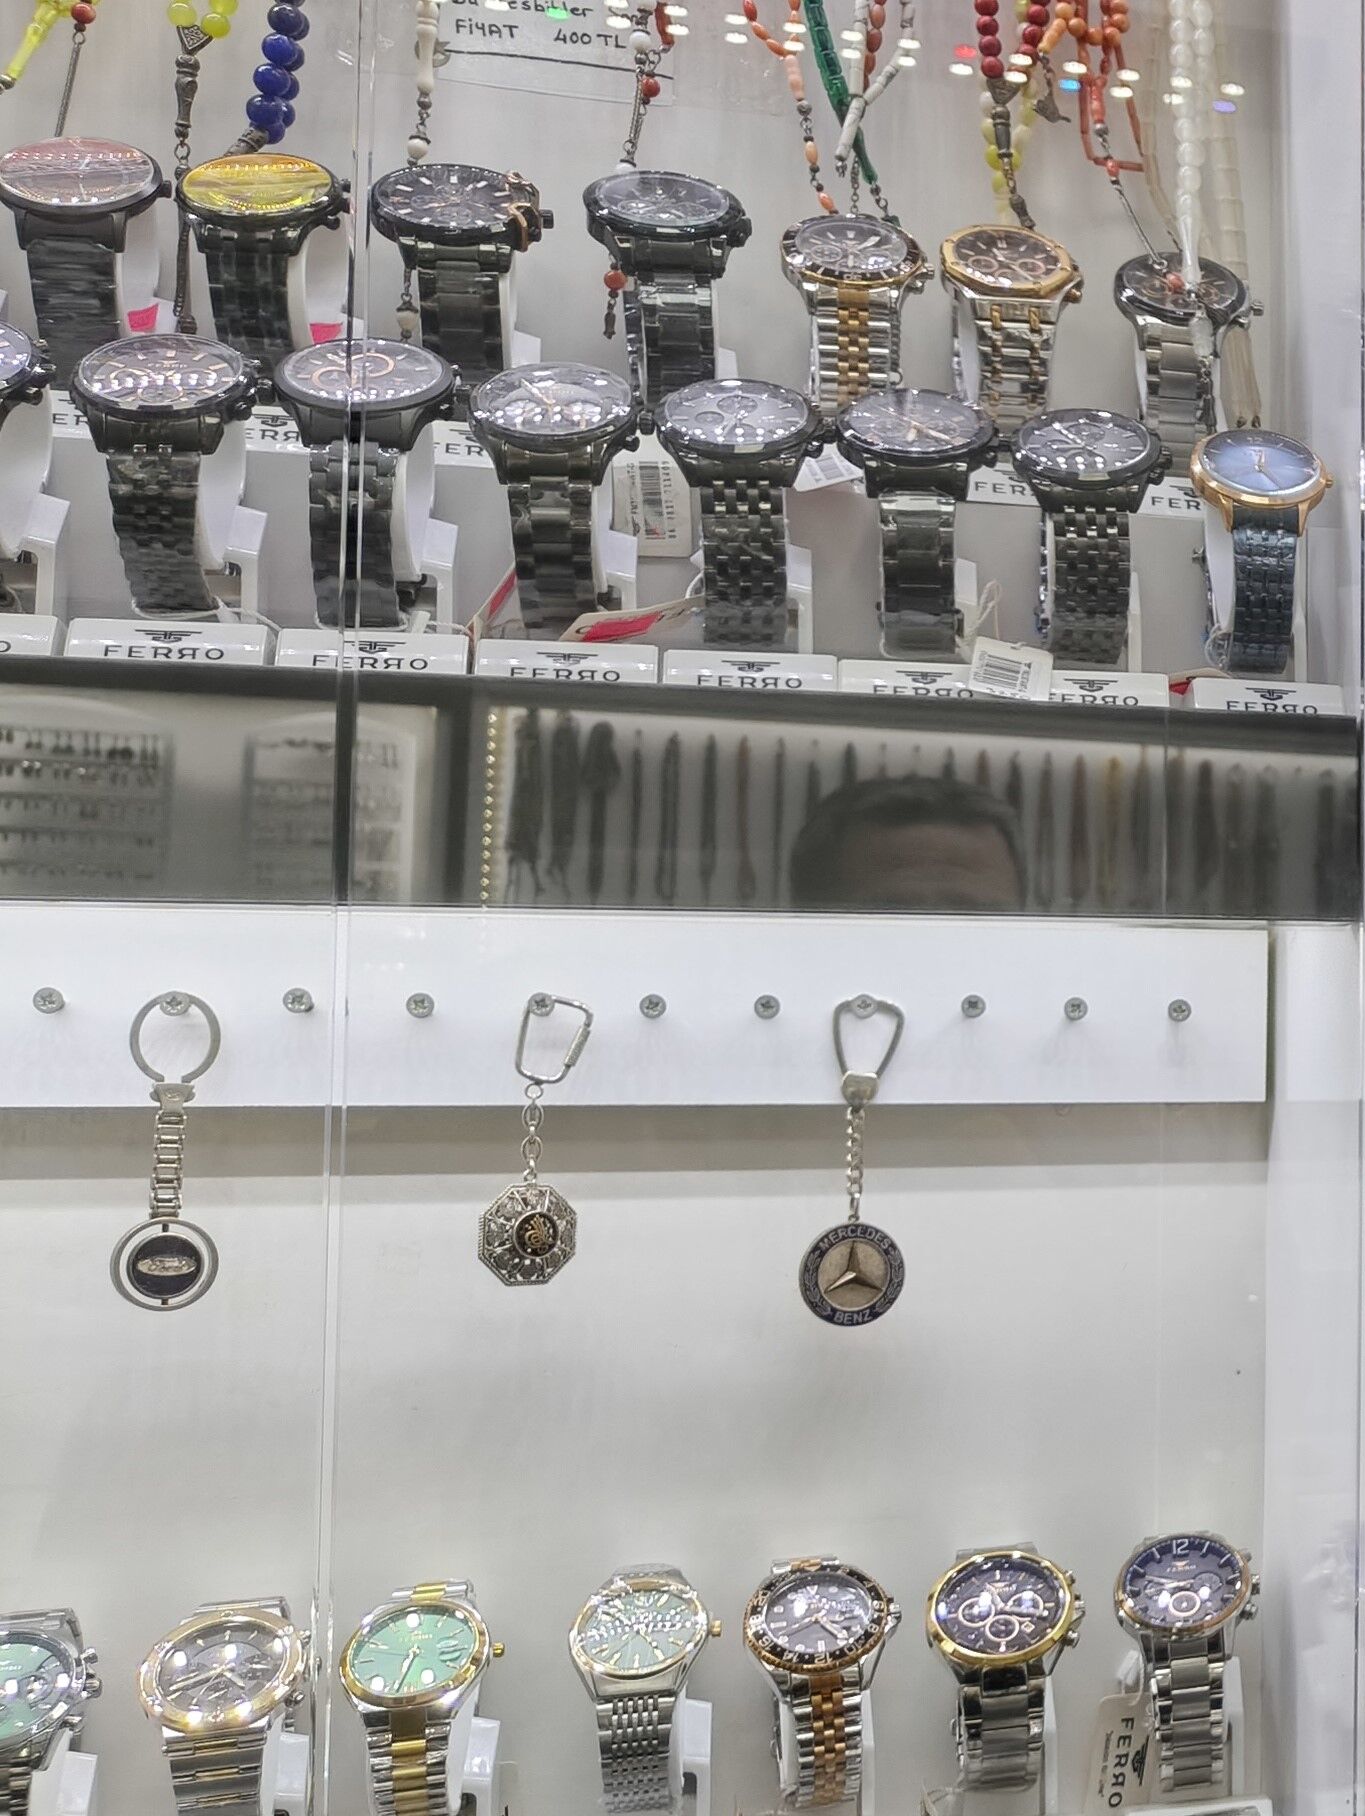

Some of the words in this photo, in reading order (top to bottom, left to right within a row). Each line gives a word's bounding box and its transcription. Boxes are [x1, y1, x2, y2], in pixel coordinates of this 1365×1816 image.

[554, 29, 592, 45] 400
[596, 34, 627, 49] TL
[103, 644, 225, 661] FERRO
[818, 1226, 893, 1251] MERCEDES
[833, 1310, 874, 1325] BENZ
[1108, 1717, 1135, 1808] FERRO
